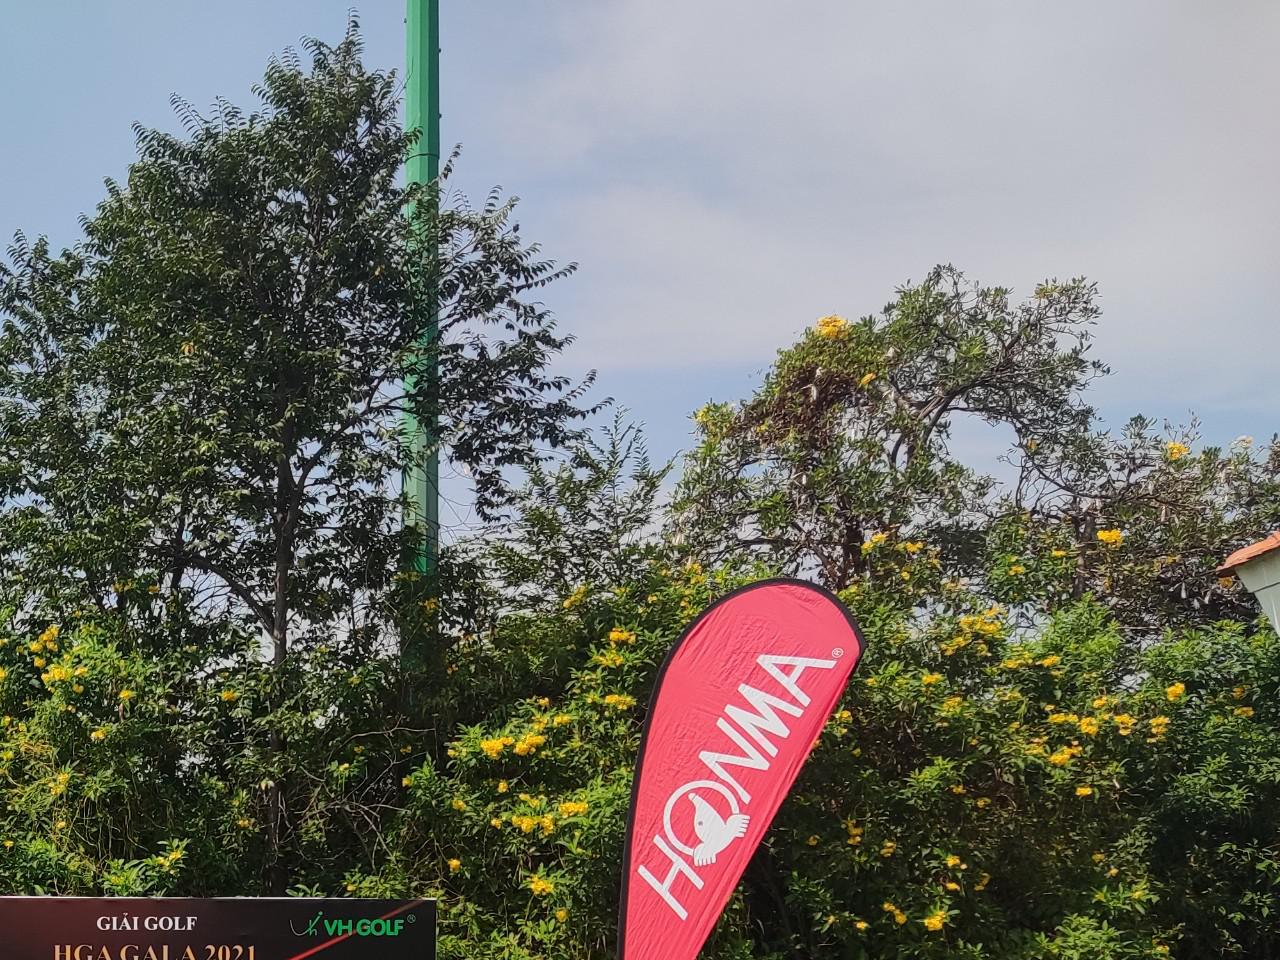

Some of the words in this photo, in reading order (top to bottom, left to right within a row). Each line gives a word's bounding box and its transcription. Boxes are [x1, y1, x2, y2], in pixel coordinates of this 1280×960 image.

[637, 654, 837, 920] HONMA
[97, 912, 140, 931] GIẢI
[144, 916, 198, 931] GOLF
[323, 919, 353, 936] VH
[356, 919, 405, 936] GOLF
